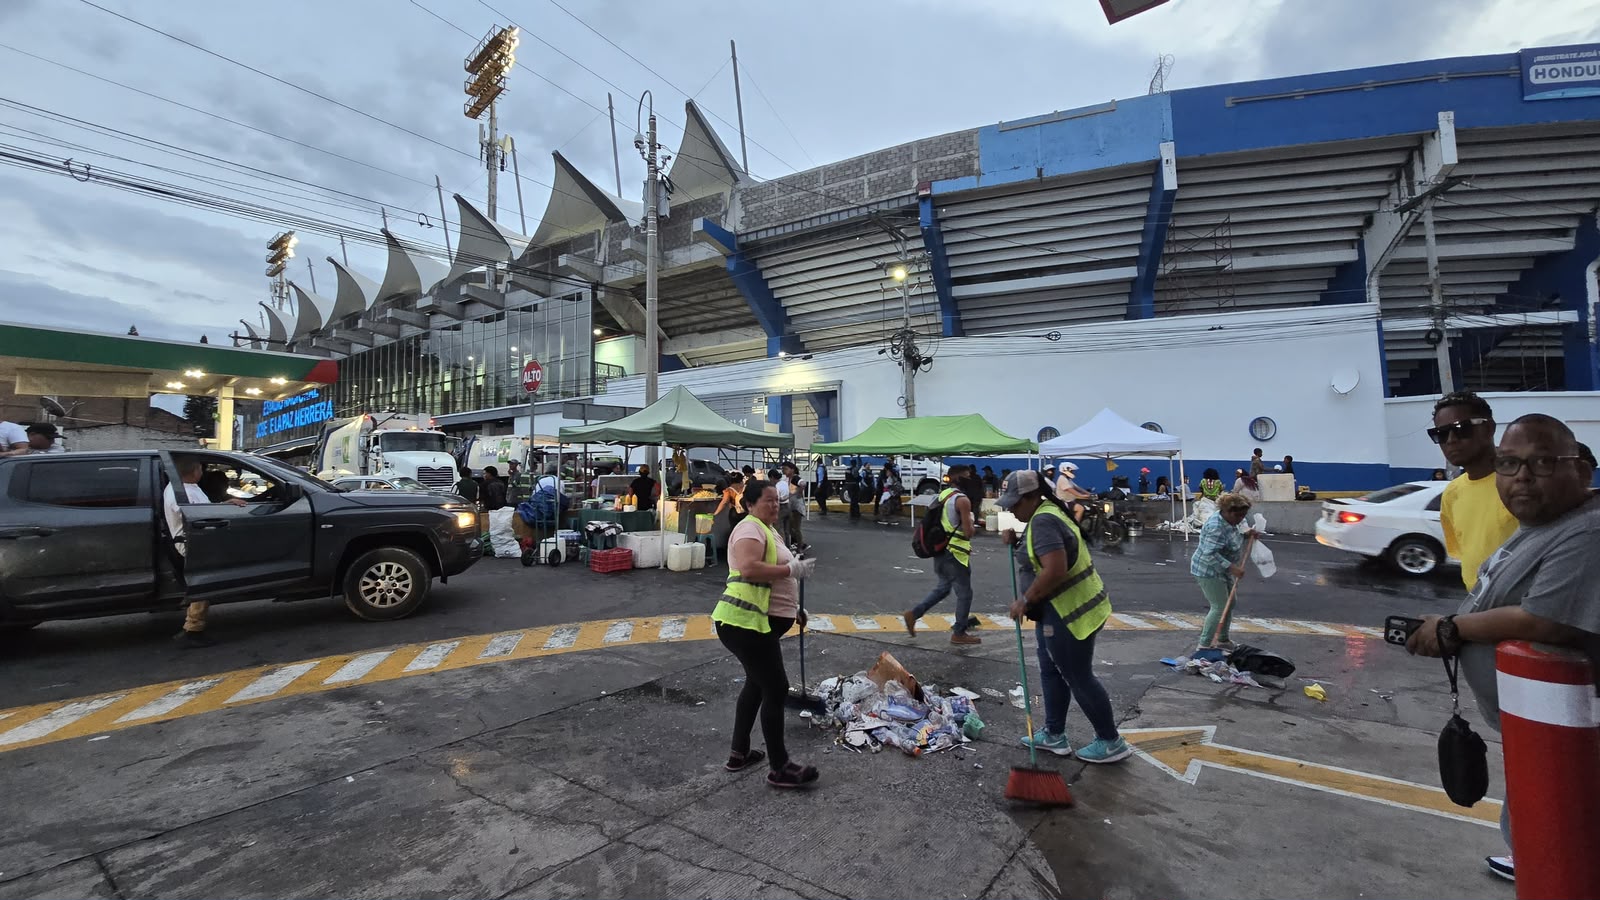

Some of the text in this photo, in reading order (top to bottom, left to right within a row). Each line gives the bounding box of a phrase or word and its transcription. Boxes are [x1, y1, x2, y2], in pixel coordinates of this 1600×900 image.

[1535, 65, 1600, 79] HONDU
[523, 369, 541, 383] ALTO
[281, 411, 293, 430] PAZ
[295, 400, 333, 427] HERRERA
[738, 418, 747, 427] 11
